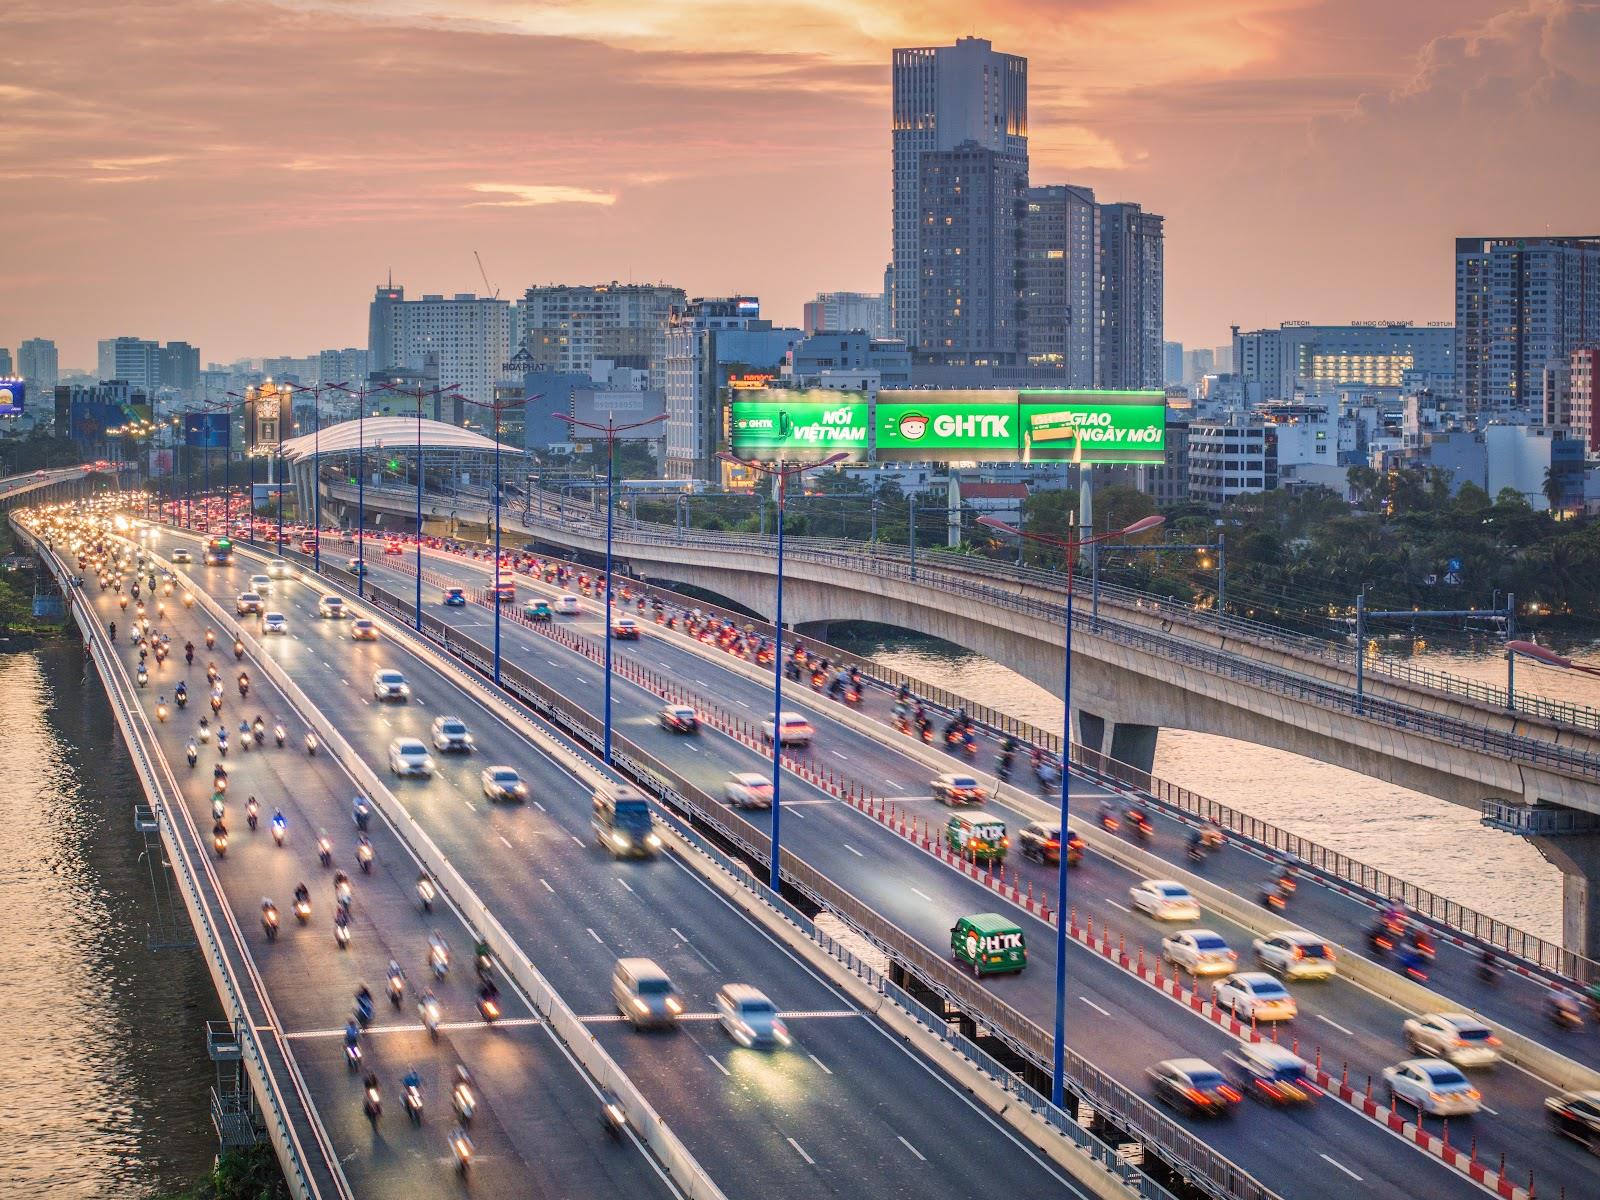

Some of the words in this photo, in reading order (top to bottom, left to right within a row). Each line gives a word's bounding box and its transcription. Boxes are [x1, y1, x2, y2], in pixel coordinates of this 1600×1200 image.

[749, 420, 773, 428] GHTK
[822, 407, 853, 425] NỐI
[934, 415, 1010, 437] GHTK
[1080, 426, 1126, 442] NGÀY
[1126, 425, 1162, 442] MỚI
